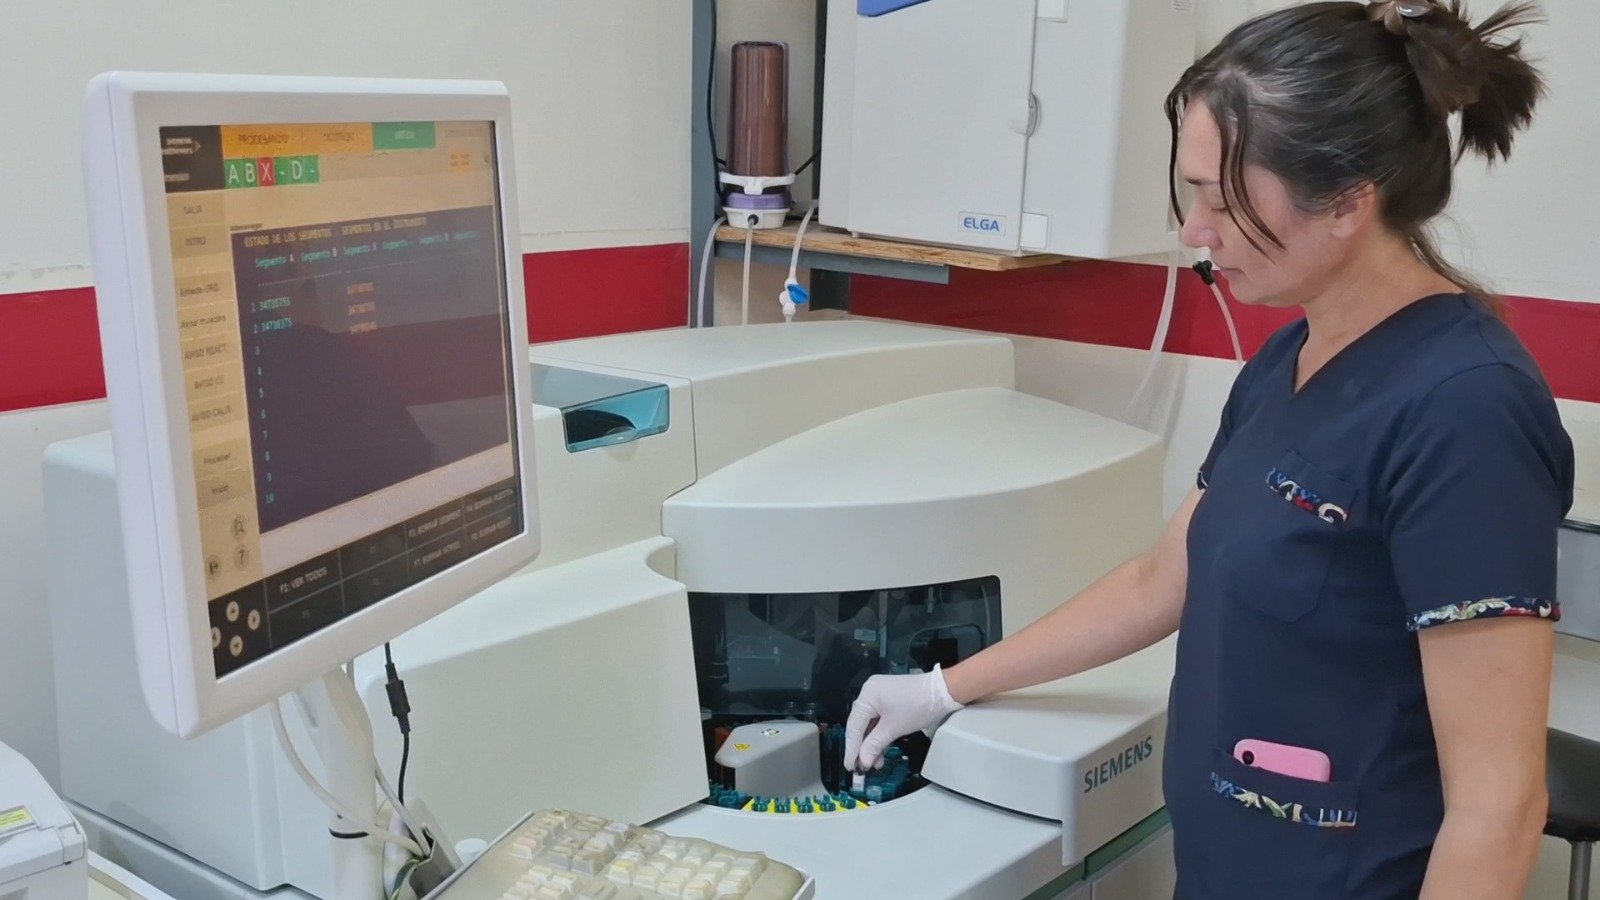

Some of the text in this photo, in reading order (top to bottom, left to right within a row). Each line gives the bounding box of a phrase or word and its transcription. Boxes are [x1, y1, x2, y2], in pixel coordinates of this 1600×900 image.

[228, 164, 240, 184] A
[245, 162, 255, 182] B
[260, 161, 272, 181] X
[291, 160, 302, 180] D
[963, 217, 1000, 231] ELGA
[244, 235, 269, 247] ESTADO
[284, 230, 296, 242] LOS
[289, 253, 295, 263] A
[265, 492, 274, 505] 10
[1084, 735, 1153, 794] SIEMENS
